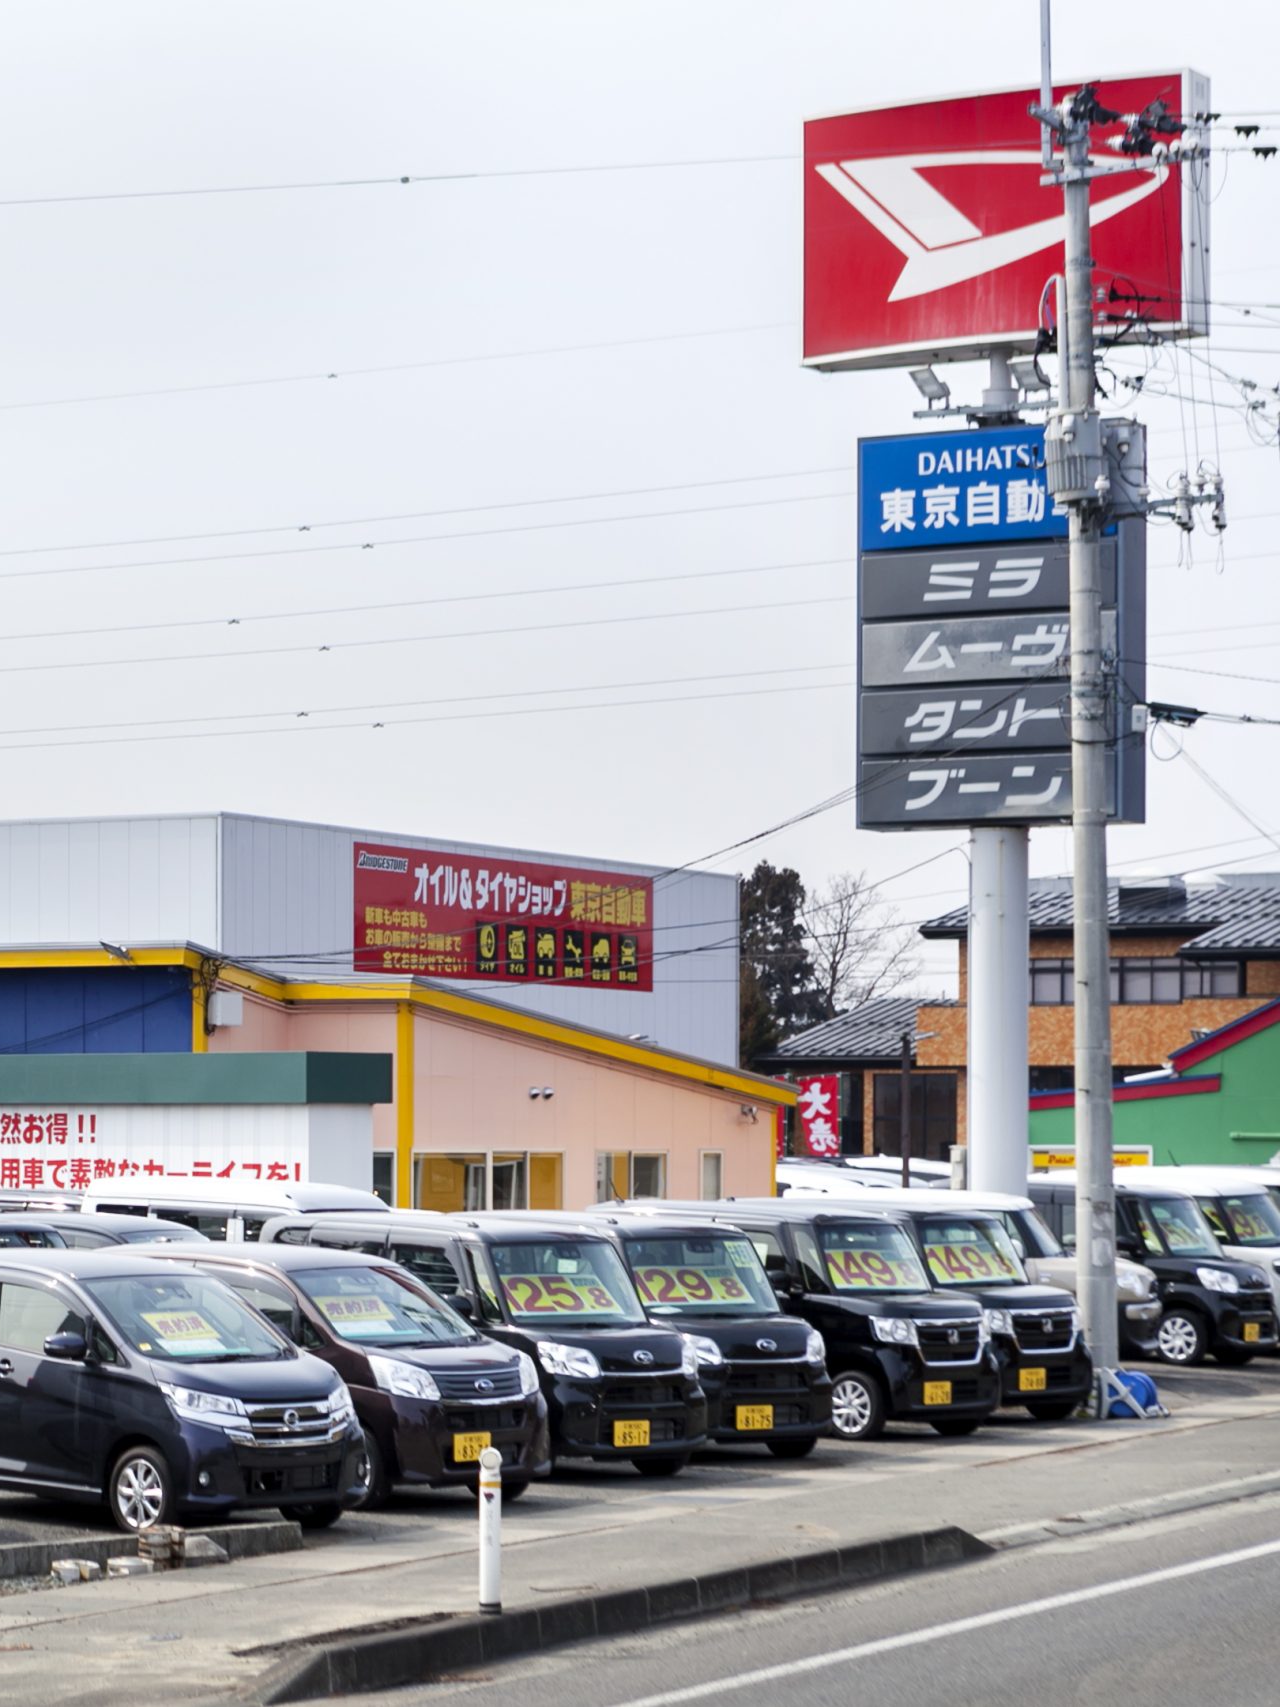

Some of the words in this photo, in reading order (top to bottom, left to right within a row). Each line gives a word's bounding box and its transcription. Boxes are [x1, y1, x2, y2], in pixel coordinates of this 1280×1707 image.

[880, 479, 1069, 534] 東京自動
[923, 557, 1044, 601] ミラ
[903, 623, 1069, 673] ムーヴ
[904, 697, 1063, 743] タント
[905, 766, 1062, 810] ブーン
[359, 852, 407, 871] BRIDGESTONE
[414, 863, 567, 917] オイル&タイヤショップ
[570, 880, 646, 927] 東京自動車
[633, 1268, 744, 1303] 129.8
[157, 1315, 205, 1334] 売約済
[325, 1298, 381, 1315] 売約済
[622, 1431, 648, 1444] 85-17
[744, 1414, 771, 1427] 81-75
